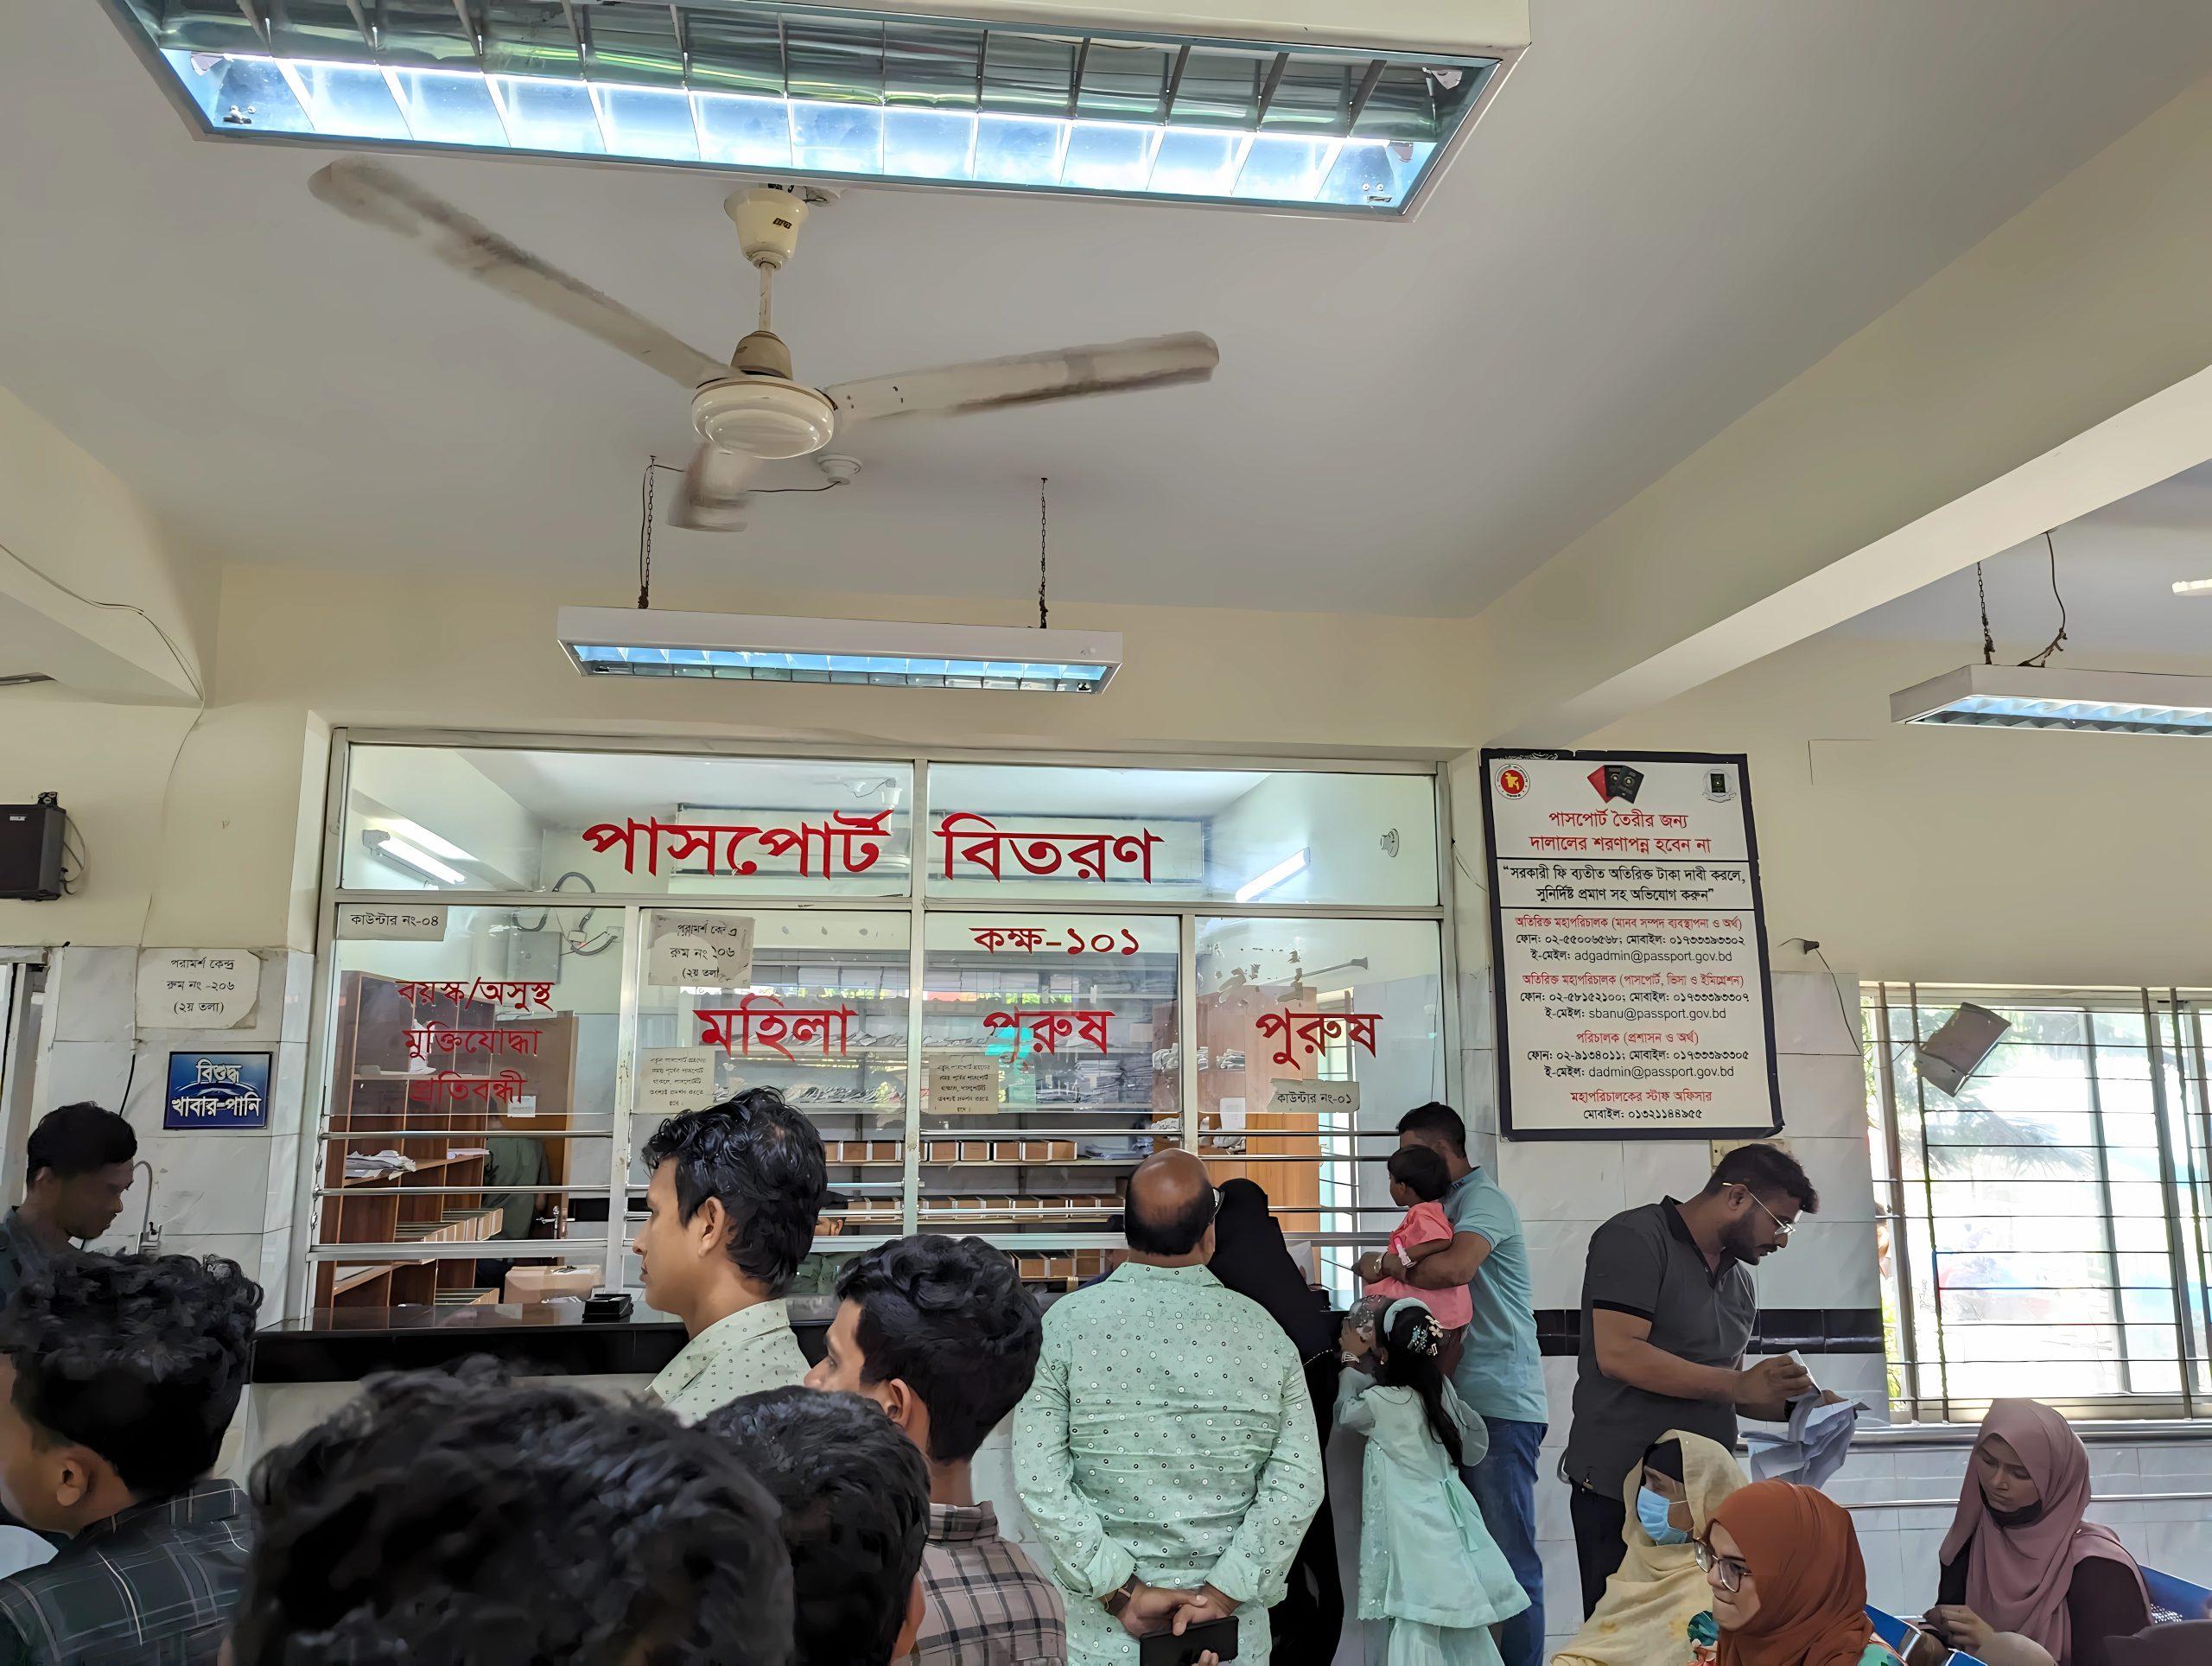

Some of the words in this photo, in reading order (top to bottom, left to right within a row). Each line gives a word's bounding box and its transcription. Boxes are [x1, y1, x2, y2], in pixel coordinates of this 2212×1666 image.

[1549, 809, 1608, 827] পাসপোর্ট
[1611, 809, 1655, 827] তৈরীর
[1658, 815, 1688, 829] জন্য
[582, 810, 894, 881] পাসপোর্ট
[931, 812, 1165, 884] বিতরণ
[1529, 836, 1587, 851] দালালের
[1592, 836, 1649, 855] শরণাপন্ন
[1654, 838, 1691, 854] হবেন
[1694, 837, 1712, 853] না
[1553, 865, 1567, 880] ফি
[1570, 865, 1605, 880] ব্যতীত
[1608, 865, 1653, 880] অতিরিক্ত
[1656, 866, 1681, 881] টাকা
[1683, 866, 1707, 881] দাবী
[1709, 870, 1745, 884] করলে,
[1535, 885, 1574, 902] সুনির্দিষ্ট
[1579, 888, 1606, 901] প্রমাণ
[1610, 890, 1629, 901] সহ
[1630, 886, 1677, 900] অভিযোগ
[350, 912, 397, 925] কাউন্টার
[402, 915, 439, 926] নং-০৪
[1515, 914, 1552, 928] অতিরিক্ত
[1554, 914, 1608, 929] মহাপরিচালক
[1611, 918, 1637, 931] (মানব
[1639, 919, 1665, 929] সম্পদ
[1667, 919, 1709, 931] ব্যবস্থাপনা
[1712, 919, 1720, 928] ও
[1722, 916, 1742, 932] অর্থ)
[969, 927, 1140, 956] কক্ষ-১০১
[1669, 935, 1745, 945] ০১৭৩৩৩৯৩৩০২
[693, 948, 709, 960] নং
[1574, 951, 1732, 963] adgadmin@passport.gov.bd
[170, 957, 207, 969] পরামর্শ
[209, 959, 235, 970] কেন্দ্র
[167, 981, 185, 991] রুম
[188, 981, 202, 991] নং
[1522, 971, 1560, 985] অতিরিক্ত
[1561, 971, 1617, 986] মহাপরিচালক
[1666, 972, 1688, 985] ভিসা
[1690, 976, 1698, 985] ও
[395, 976, 556, 1012] বয়স্ক/অসুস্থ
[1673, 993, 1750, 1002] ০১৭৩৩৩৯৩৩০৭
[174, 1002, 194, 1014] (২য়
[198, 1002, 225, 1014] তলা)
[1588, 1008, 1726, 1021] sbanu@passport.gov.bd
[692, 993, 860, 1062] মহিলা
[402, 1021, 543, 1061] মুক্তিযোদ্ধা
[982, 1005, 1117, 1071] পুরুষ
[1255, 1007, 1384, 1071] পুরুষ
[1576, 1029, 1621, 1043] পরিচালক
[1624, 1032, 1662, 1046] (প্রশাসন
[1665, 1033, 1674, 1043] ও
[1676, 1029, 1699, 1046] অর্থ)
[1673, 1051, 1749, 1060] ০১৭৩৩৩৯৩৩০৫
[195, 1058, 243, 1084] বিশুদ্ধ
[1588, 1066, 1734, 1079] dadmin@passport.gov.bd
[408, 1069, 529, 1107] প্রতিবন্ধী
[1569, 1089, 1643, 1103] মহাপরিচালকের
[1645, 1089, 1670, 1102] স্টাফ
[1673, 1089, 1713, 1102] অফিসার
[171, 1091, 263, 1117] খাবার-পানি
[1277, 1091, 1317, 1104] কাউন্টার
[1319, 1093, 1352, 1104] নং-০১
[1628, 1109, 1703, 1120] ০১৩২১১৪৪৯৫৫
